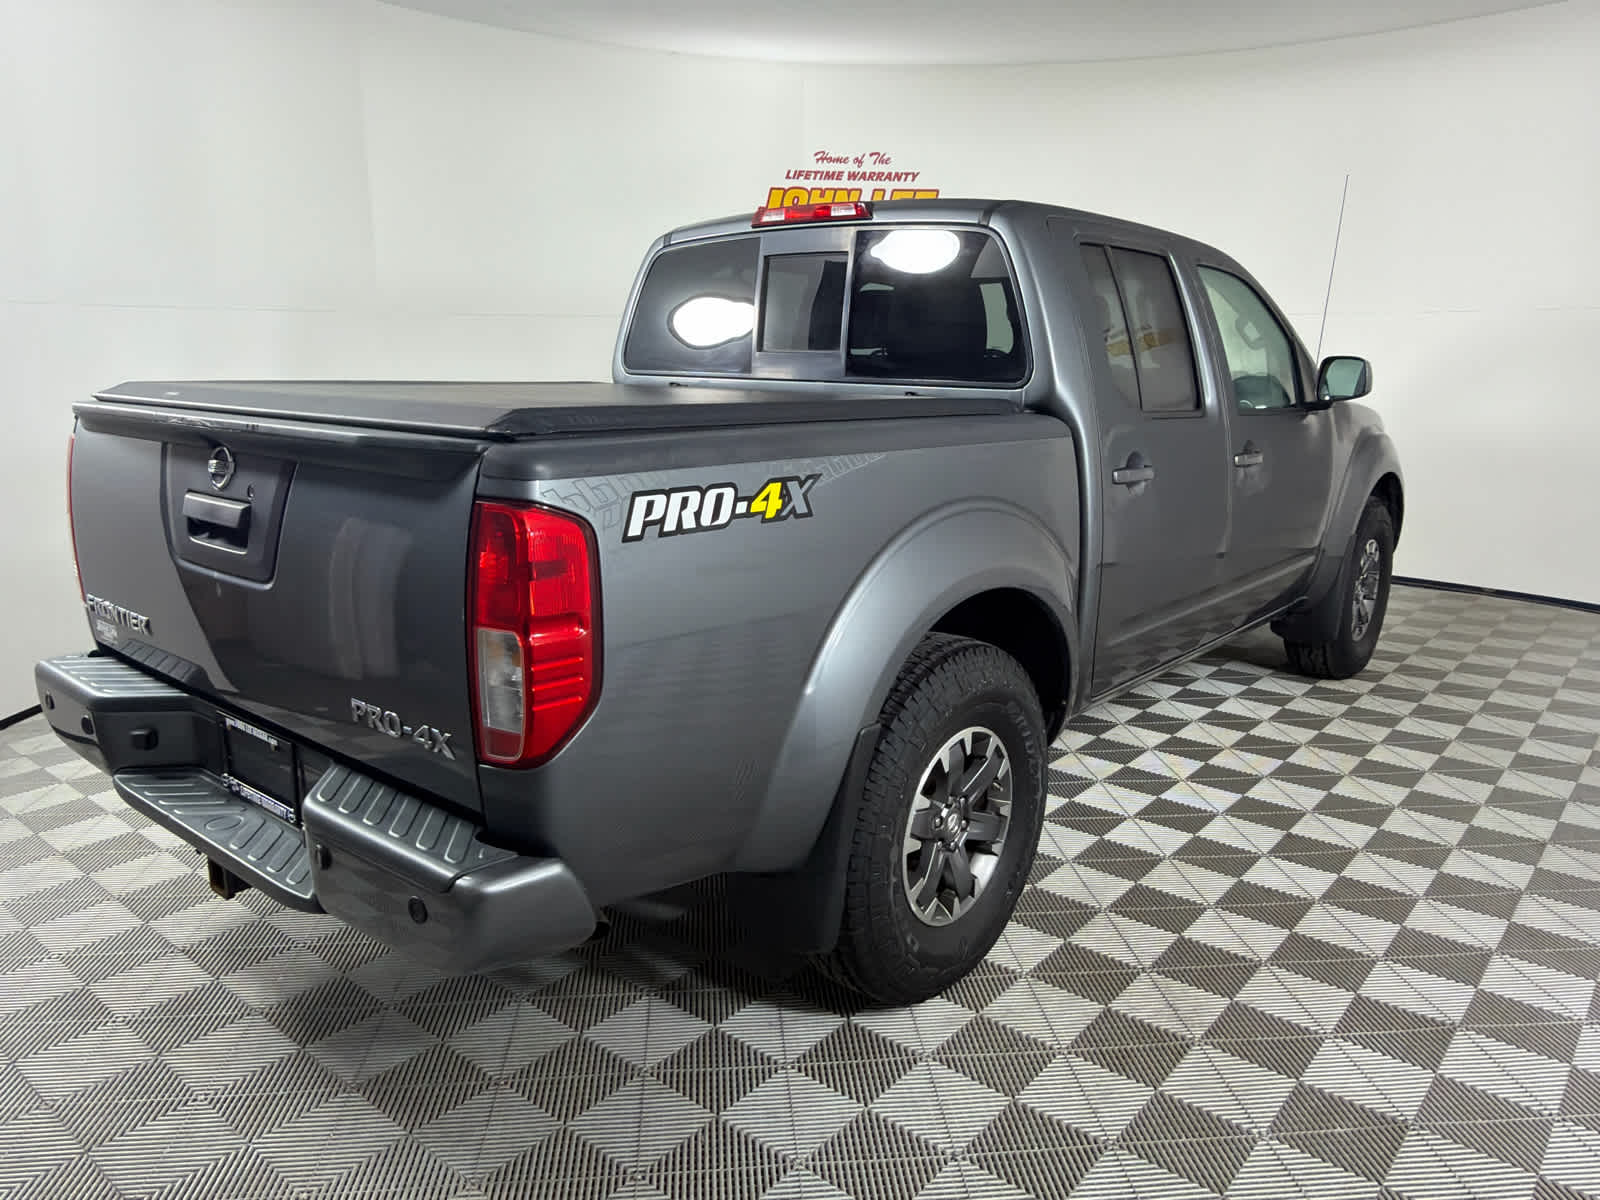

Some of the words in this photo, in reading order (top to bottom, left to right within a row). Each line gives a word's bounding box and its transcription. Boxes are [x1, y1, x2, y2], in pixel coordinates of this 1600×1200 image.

[785, 170, 844, 181] LIFETIME
[847, 171, 920, 182] WARRANTY
[814, 151, 849, 165] Home
[853, 153, 864, 168] of
[869, 152, 892, 165] The
[621, 473, 822, 543] PRO-4X
[86, 593, 154, 637] FRONTIER
[351, 697, 456, 760] PRO-4X
